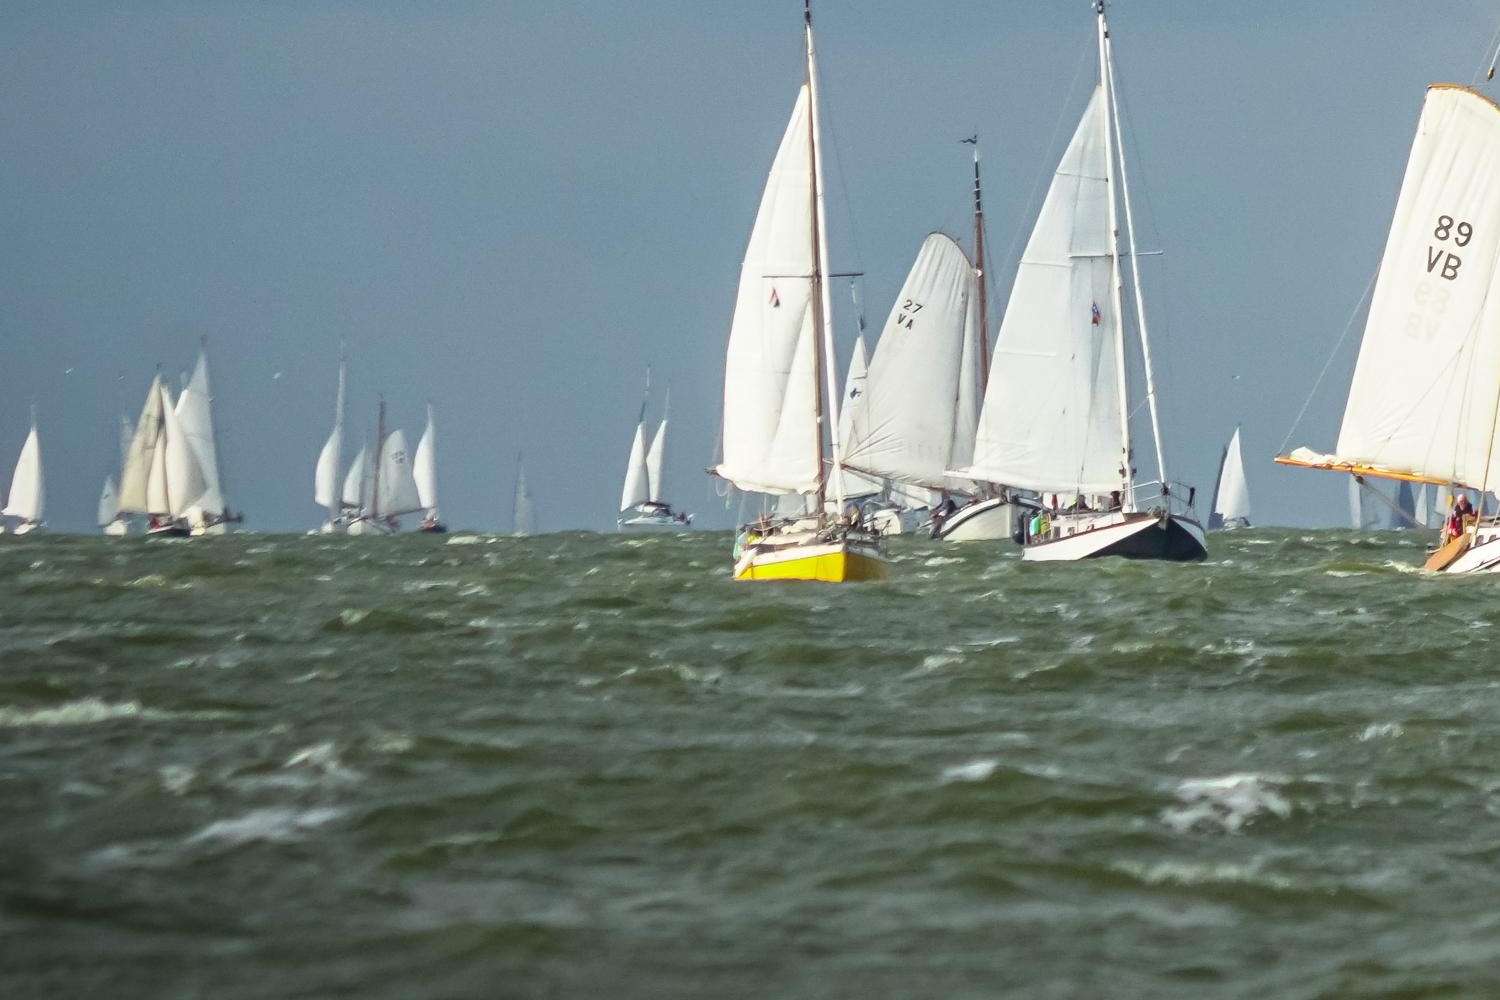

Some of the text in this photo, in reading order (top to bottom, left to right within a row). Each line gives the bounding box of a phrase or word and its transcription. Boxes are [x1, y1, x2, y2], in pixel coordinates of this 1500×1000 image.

[1434, 214, 1473, 247] 89
[1427, 245, 1462, 281] VB
[903, 299, 924, 314] 27
[897, 313, 914, 330] VA
